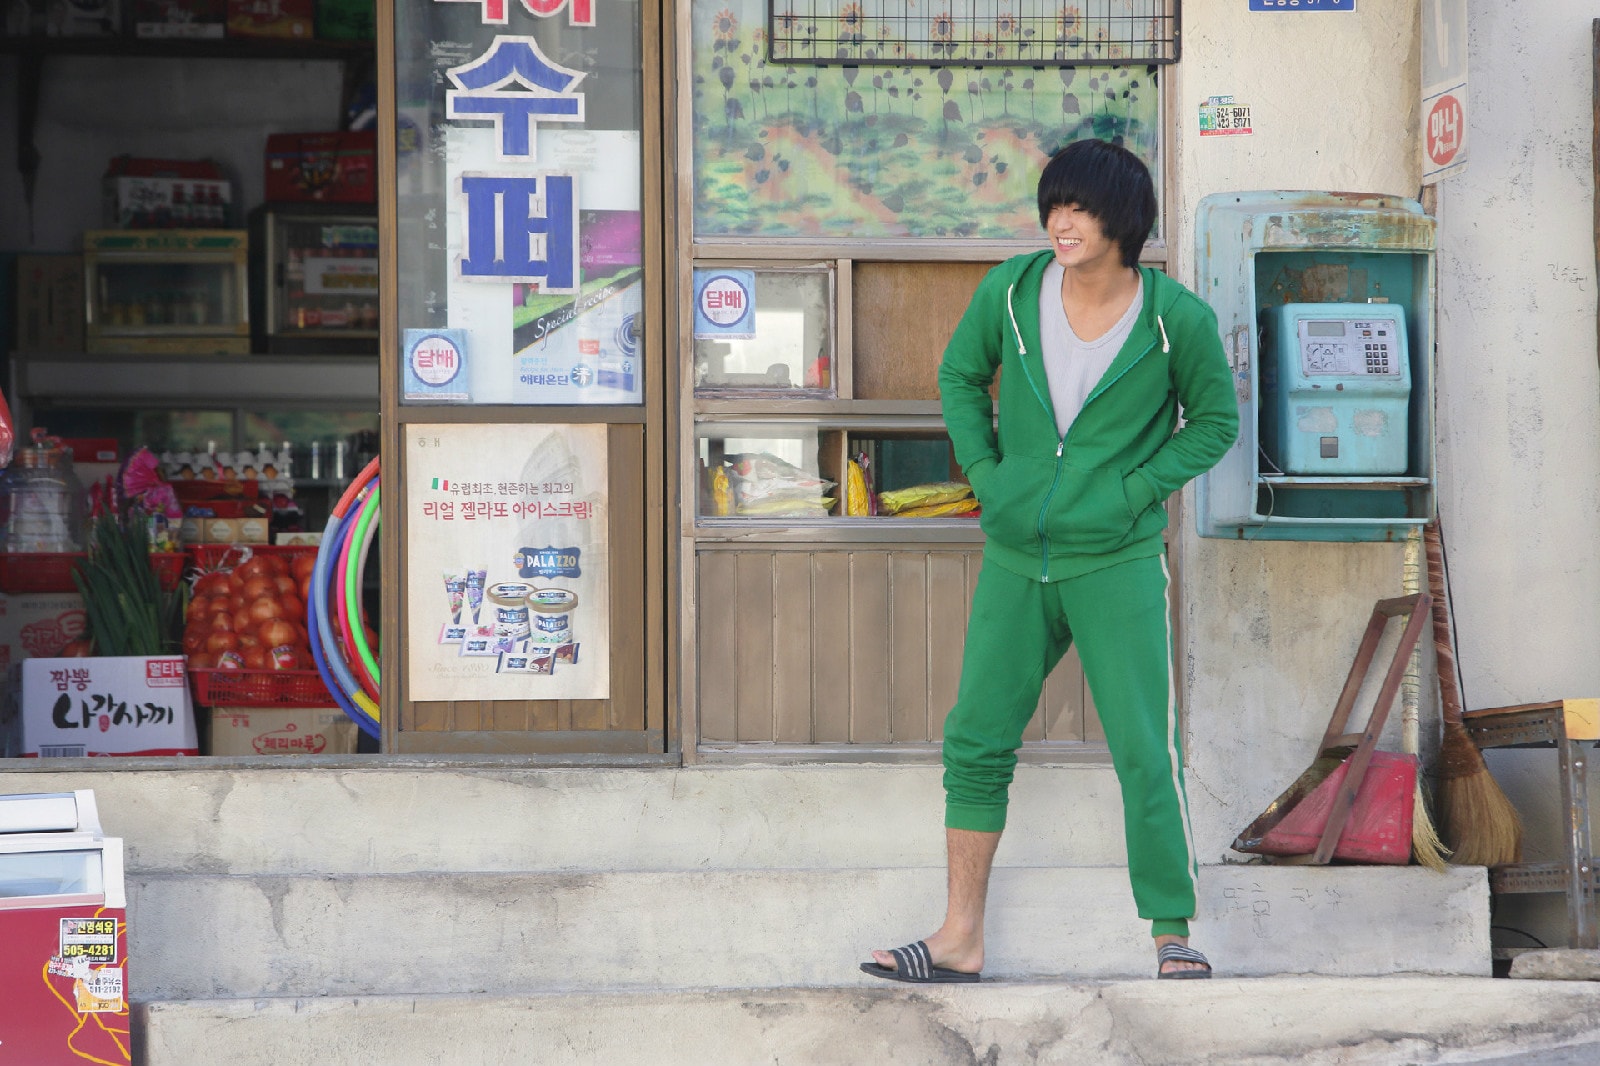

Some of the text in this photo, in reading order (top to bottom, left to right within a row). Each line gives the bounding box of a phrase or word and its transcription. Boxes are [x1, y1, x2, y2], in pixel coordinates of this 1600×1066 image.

[1216, 107, 1250, 118] 524-6071
[706, 290, 742, 309] 담배
[534, 284, 616, 351] Special recipe
[417, 348, 454, 368] 담배
[497, 482, 539, 496] 현존하는
[542, 482, 574, 495] 최고의
[423, 501, 593, 520] 리얼 젤라또 아이스크림!
[526, 555, 577, 568] PALAZZO
[50, 668, 92, 692] 짬뽕
[263, 734, 316, 750] 체리마루
[63, 945, 114, 956] 505-4281
